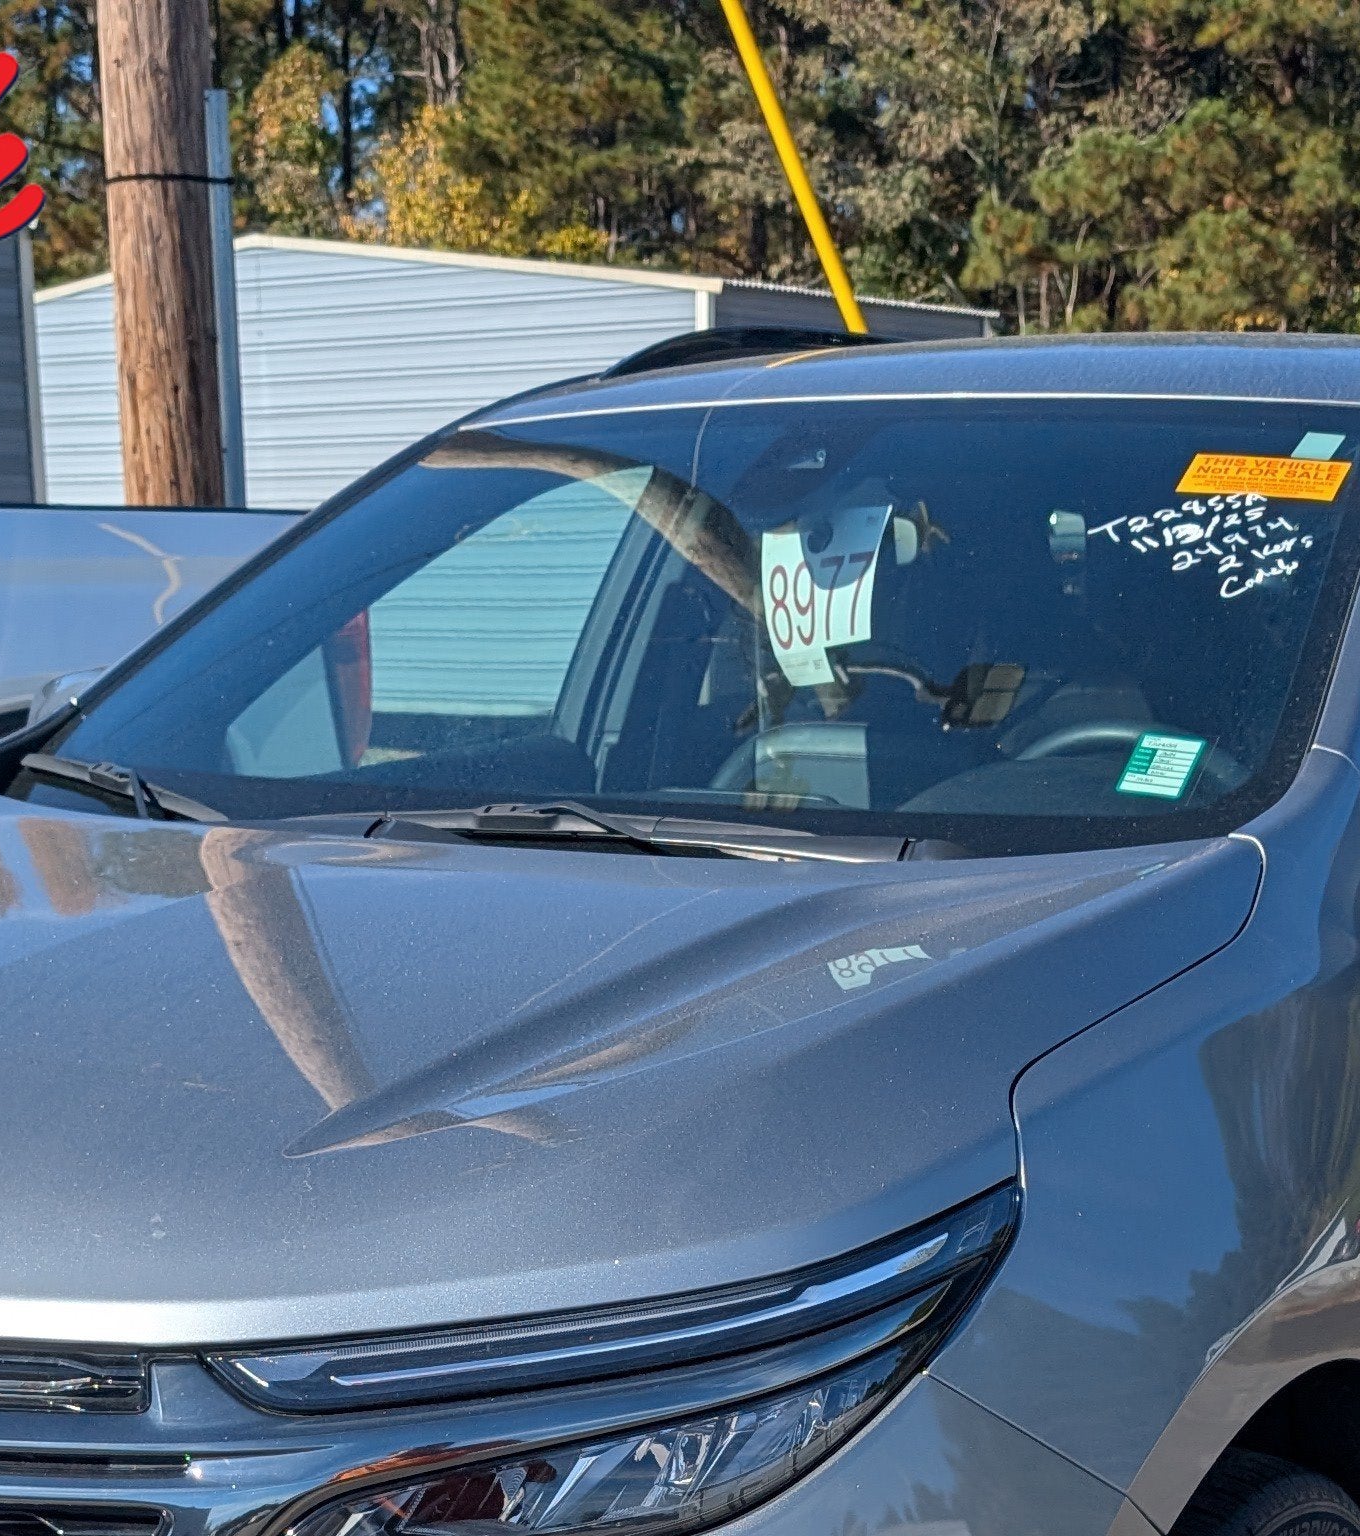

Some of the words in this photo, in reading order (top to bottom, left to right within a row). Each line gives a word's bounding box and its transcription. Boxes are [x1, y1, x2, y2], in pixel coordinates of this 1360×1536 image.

[1196, 465, 1230, 475] Not
[1236, 467, 1278, 478] FOR
[1284, 470, 1340, 482] SALE
[1202, 457, 1247, 467] THIS
[1254, 459, 1342, 472] VEHICLE
[1217, 553, 1244, 574] 2
[769, 551, 875, 650] 8977
